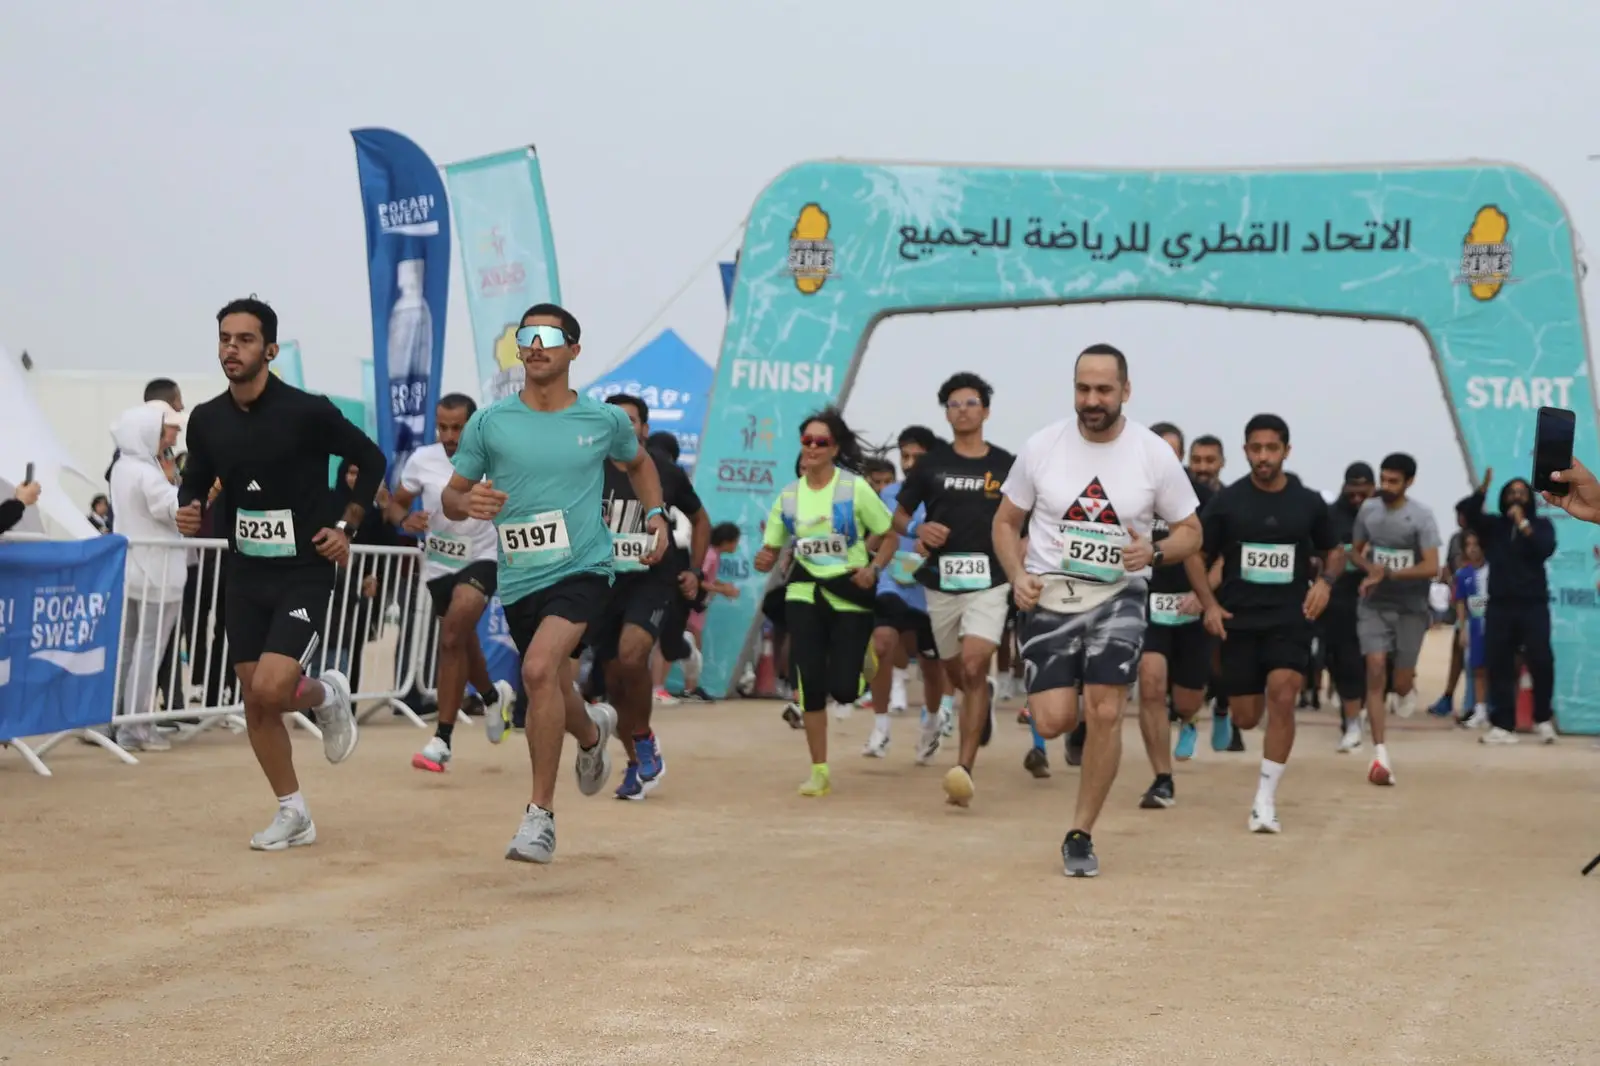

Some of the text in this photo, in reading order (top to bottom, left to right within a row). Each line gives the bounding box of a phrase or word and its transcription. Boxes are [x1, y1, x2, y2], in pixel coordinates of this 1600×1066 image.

[378, 194, 434, 215] POCARI
[380, 207, 429, 228] SWEAT
[899, 217, 1411, 268] الاتحاد القطري للرياضة للجميع
[731, 359, 834, 393] FINISH
[1466, 376, 1574, 409] START
[717, 464, 774, 487] QSEA
[240, 520, 287, 539] 5234
[505, 522, 558, 550] 5197
[430, 538, 466, 557] 5222
[612, 541, 643, 557] 199
[803, 539, 842, 556] 5216
[1069, 540, 1122, 565] 5235
[944, 560, 986, 575] 5238
[1247, 552, 1290, 568] 5208
[33, 592, 110, 622] POCARI
[31, 619, 98, 649] SWEAT
